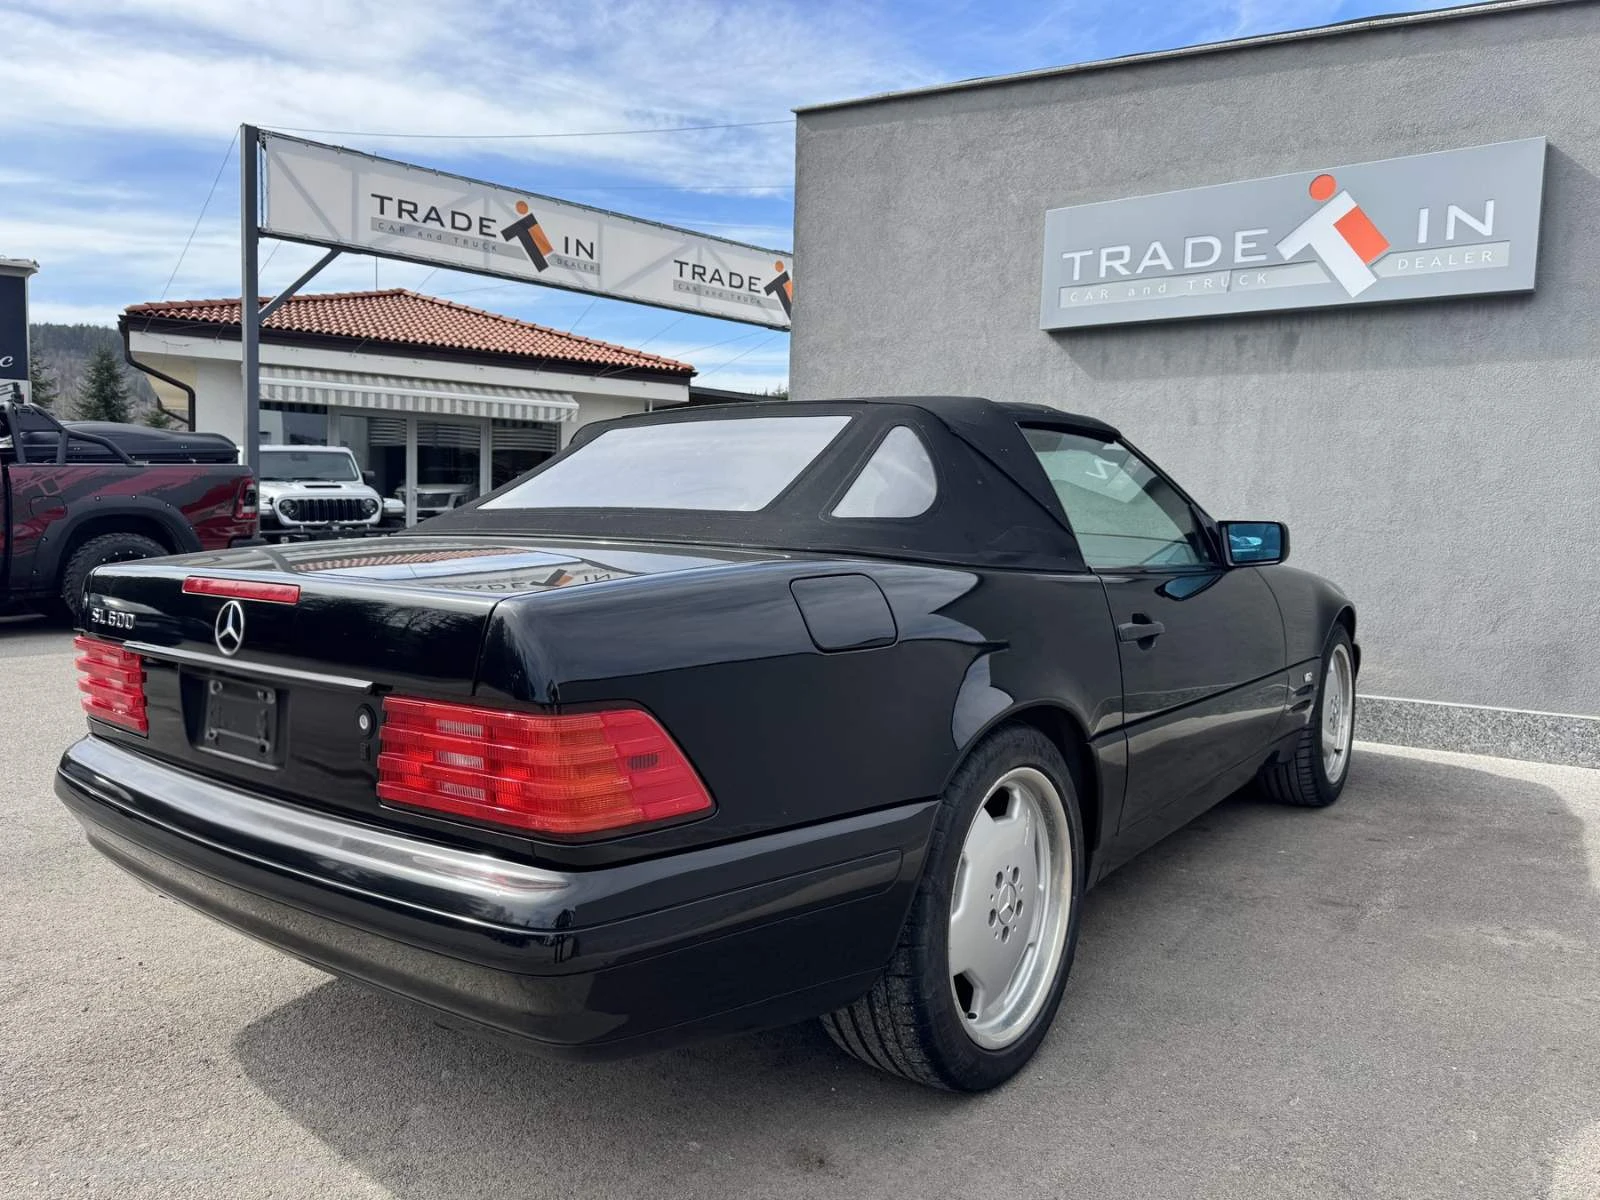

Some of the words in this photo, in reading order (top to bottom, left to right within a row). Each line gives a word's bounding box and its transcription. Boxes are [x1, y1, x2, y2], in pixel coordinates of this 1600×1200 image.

[371, 193, 497, 238] TRADE
[564, 236, 594, 260] IN
[377, 222, 406, 234] CAR
[418, 231, 442, 241] and
[454, 235, 498, 252] TRUCK
[1062, 229, 1269, 280] TRADE
[1417, 199, 1495, 244] IN
[674, 259, 762, 294] TRADE
[1070, 287, 1110, 303] CAR
[1127, 282, 1167, 297] and
[1187, 272, 1268, 292] TRUCK
[1397, 251, 1494, 270] DEALER
